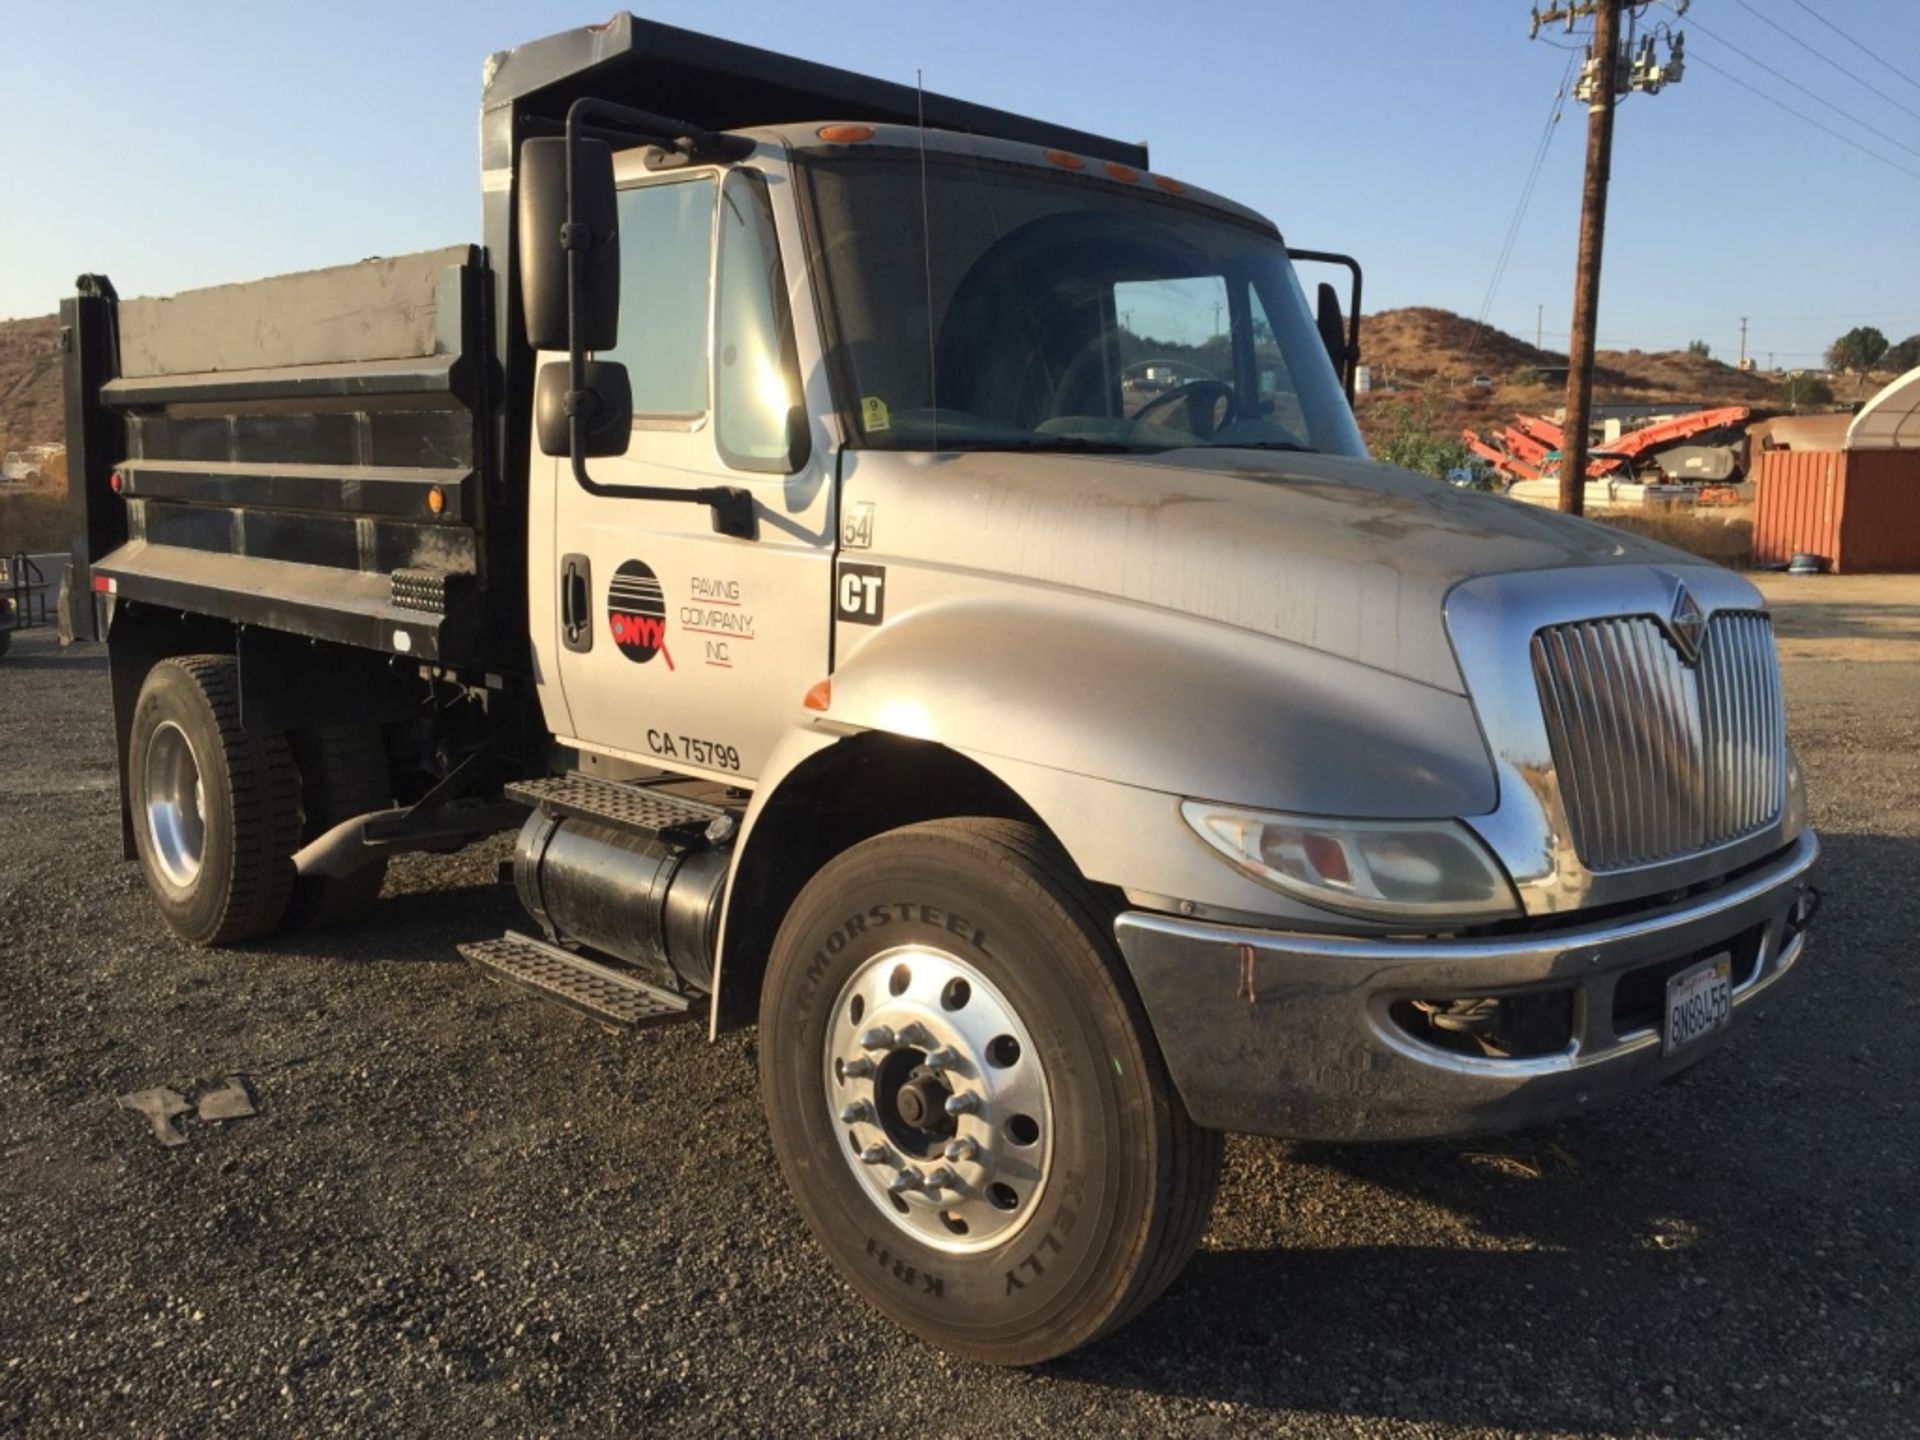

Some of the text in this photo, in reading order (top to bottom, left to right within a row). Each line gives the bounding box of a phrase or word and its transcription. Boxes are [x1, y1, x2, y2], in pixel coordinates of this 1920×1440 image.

[844, 514, 869, 545] 54
[691, 577, 740, 600] PAVING
[841, 573, 882, 615] CT
[610, 612, 668, 658] ONYX
[705, 640, 732, 662] INC.
[647, 728, 740, 771] CA 75799
[1004, 1168, 1086, 1297] KELLY
